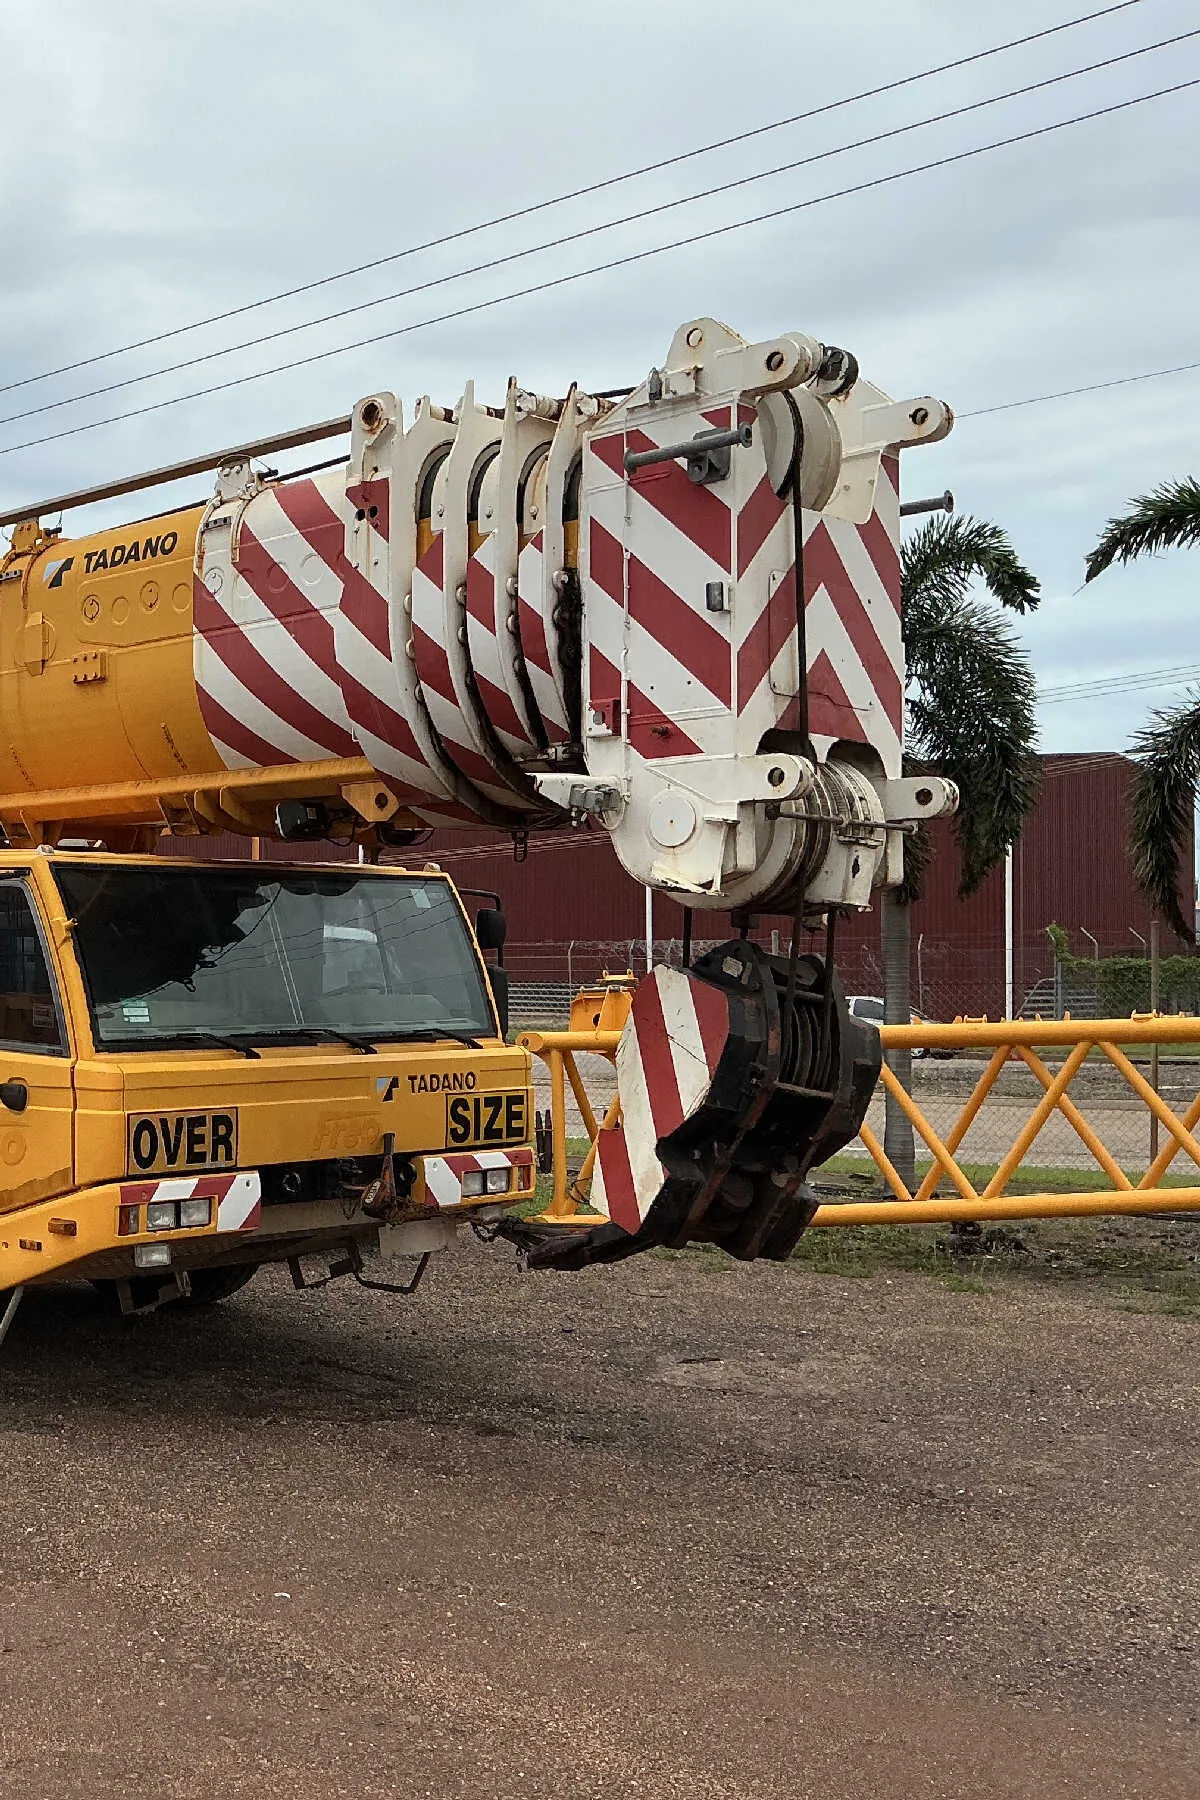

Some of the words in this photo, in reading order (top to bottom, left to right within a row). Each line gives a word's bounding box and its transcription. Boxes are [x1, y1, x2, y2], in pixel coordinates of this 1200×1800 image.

[84, 531, 178, 574] TADANO
[407, 1071, 477, 1094] TADANO
[132, 1114, 234, 1170] OVER
[449, 1094, 525, 1144] SIZE
